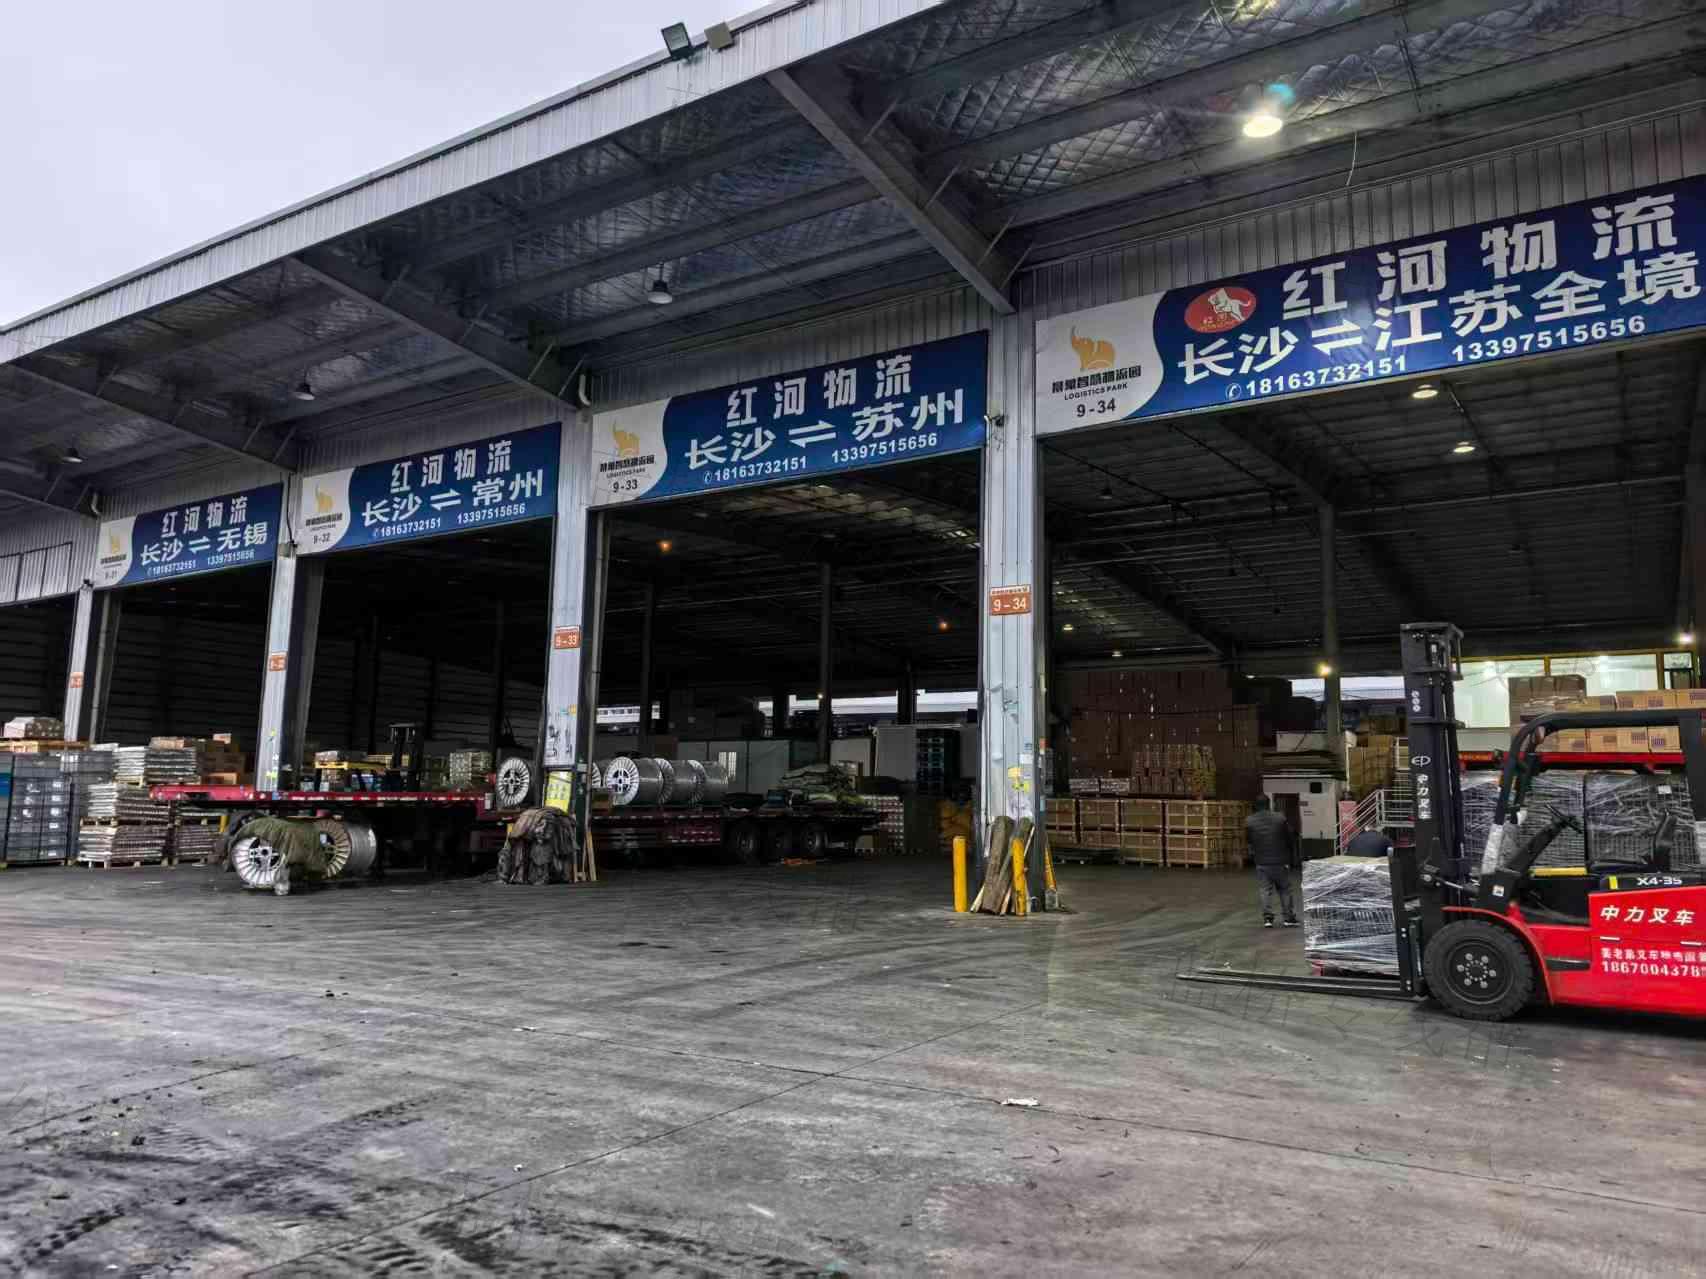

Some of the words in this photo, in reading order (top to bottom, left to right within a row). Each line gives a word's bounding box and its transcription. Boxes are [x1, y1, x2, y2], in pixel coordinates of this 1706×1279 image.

[1282, 193, 1678, 320] 红河物流
[1177, 325, 1296, 384] 长沙
[1375, 250, 1702, 352] 江苏全境
[1245, 354, 1407, 396] 18163732151
[1451, 315, 1646, 362] 13397515656
[726, 355, 912, 428] 红河物流
[1064, 388, 1105, 401] LOGISTICS
[1106, 382, 1128, 393] PARK
[1076, 398, 1117, 418] 9-34
[685, 426, 776, 471] 长沙
[851, 388, 964, 441] 苏州
[390, 440, 513, 495] 红河物流
[714, 456, 808, 482] 18163732151
[831, 432, 938, 463] 13397515656
[362, 493, 423, 528] 长沙
[472, 469, 543, 508] 常州
[613, 479, 638, 493] 9-33
[161, 496, 248, 539] 红河物流
[379, 517, 442, 538] 18163732151
[456, 503, 526, 524] 13397515656
[142, 539, 184, 566] 长沙
[217, 522, 268, 552] 无锡
[992, 597, 1027, 612] 9-34
[1417, 773, 1432, 820] 中力叉车
[1637, 876, 1683, 886] X4-35
[1600, 904, 1695, 926] 中力叉车
